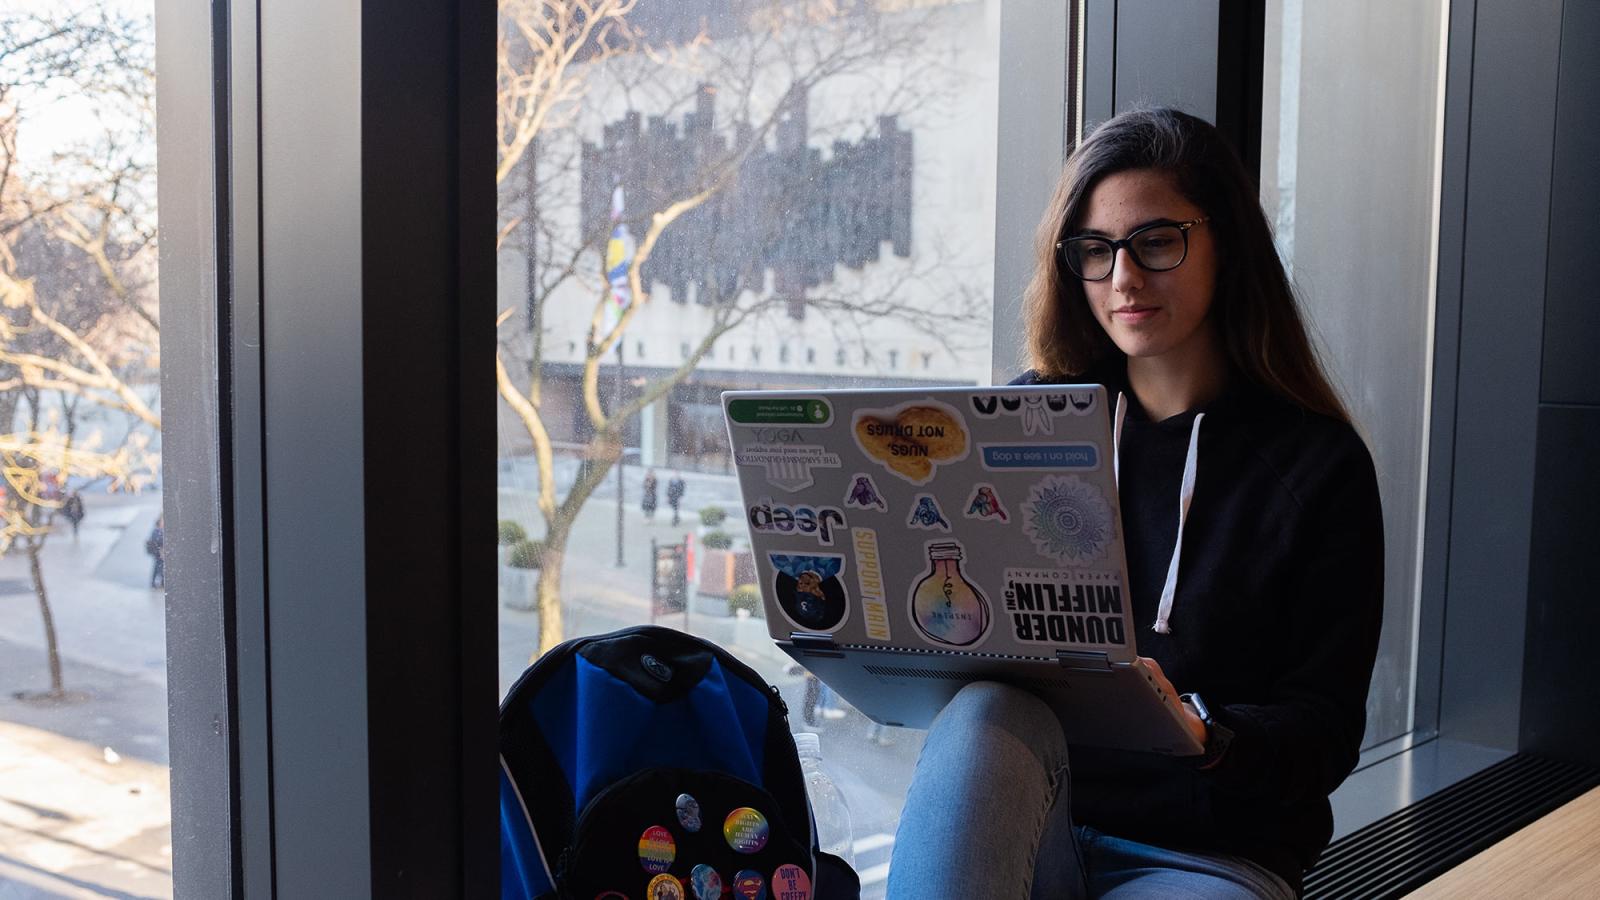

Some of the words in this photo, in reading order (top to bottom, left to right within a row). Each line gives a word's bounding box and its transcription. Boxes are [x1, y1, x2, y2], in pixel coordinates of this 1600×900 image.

[867, 424, 912, 437] DRUGS
[918, 426, 944, 437] NOT
[888, 444, 928, 456] NUGS,
[736, 455, 786, 465] FOUNDATION
[823, 456, 838, 465] THE
[992, 451, 1012, 462] dog
[1066, 452, 1088, 461] hold
[750, 499, 843, 542] Jeep
[855, 531, 883, 596] SUPPORT
[1007, 571, 1068, 580] COMPANY
[1079, 573, 1119, 581] PAPER
[800, 601, 808, 611] 3
[1014, 613, 1125, 644] DUNDER
[780, 868, 800, 880] DON'T
[788, 880, 797, 890] BE
[781, 891, 807, 900] CREEPY
